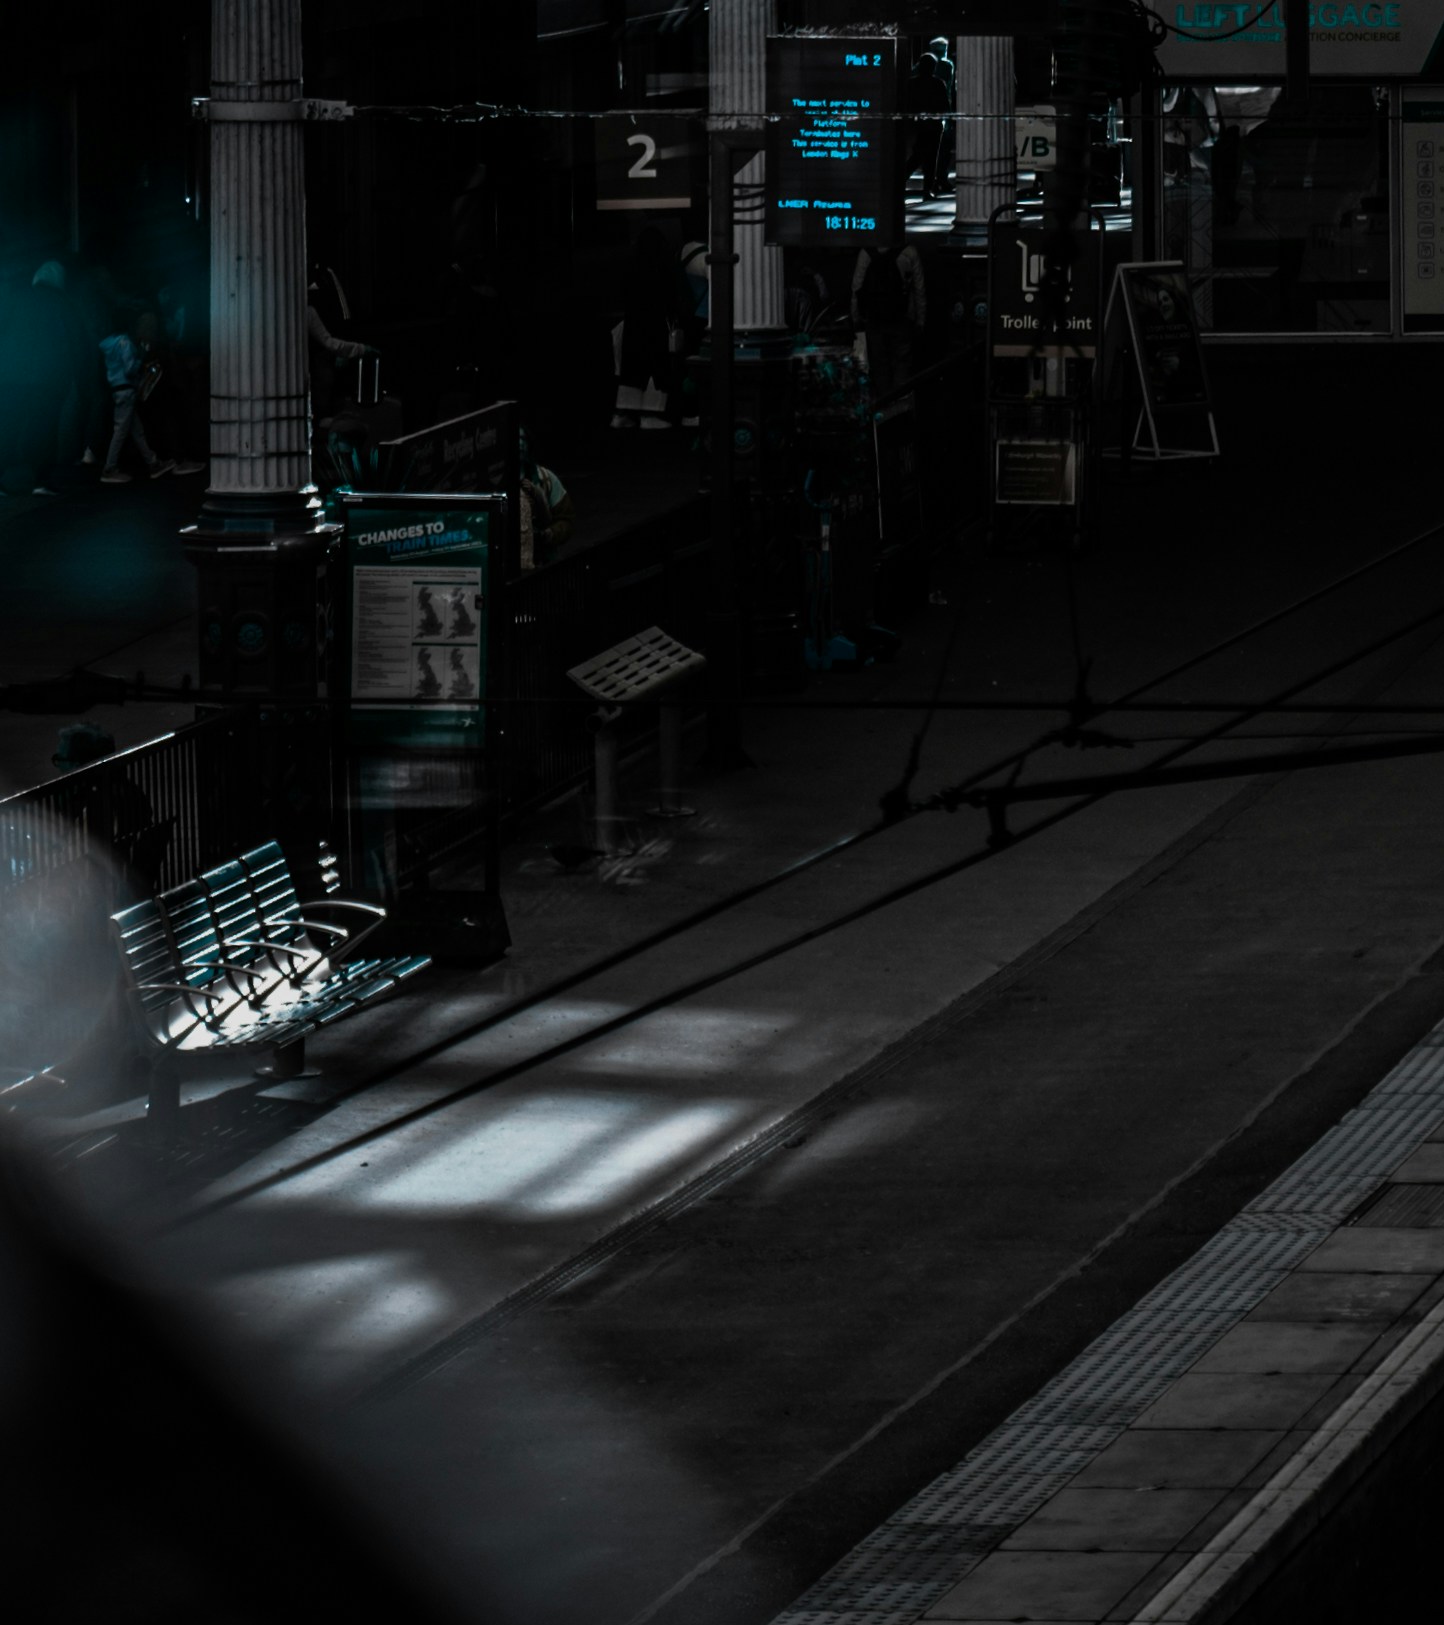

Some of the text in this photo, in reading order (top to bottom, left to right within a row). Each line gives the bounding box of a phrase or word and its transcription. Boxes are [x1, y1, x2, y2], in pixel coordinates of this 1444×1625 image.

[1176, 2, 1250, 29] LEFT
[1338, 32, 1401, 42] CONCIERGE
[845, 53, 882, 67] Plat 2
[792, 98, 870, 108] The next service to
[813, 118, 848, 128] Platform
[850, 139, 869, 148] from
[626, 133, 657, 179] 2
[802, 149, 829, 159] London
[999, 314, 1047, 331] Trolle
[357, 520, 445, 546] CHANGES TO
[385, 534, 427, 555] TRAIN
